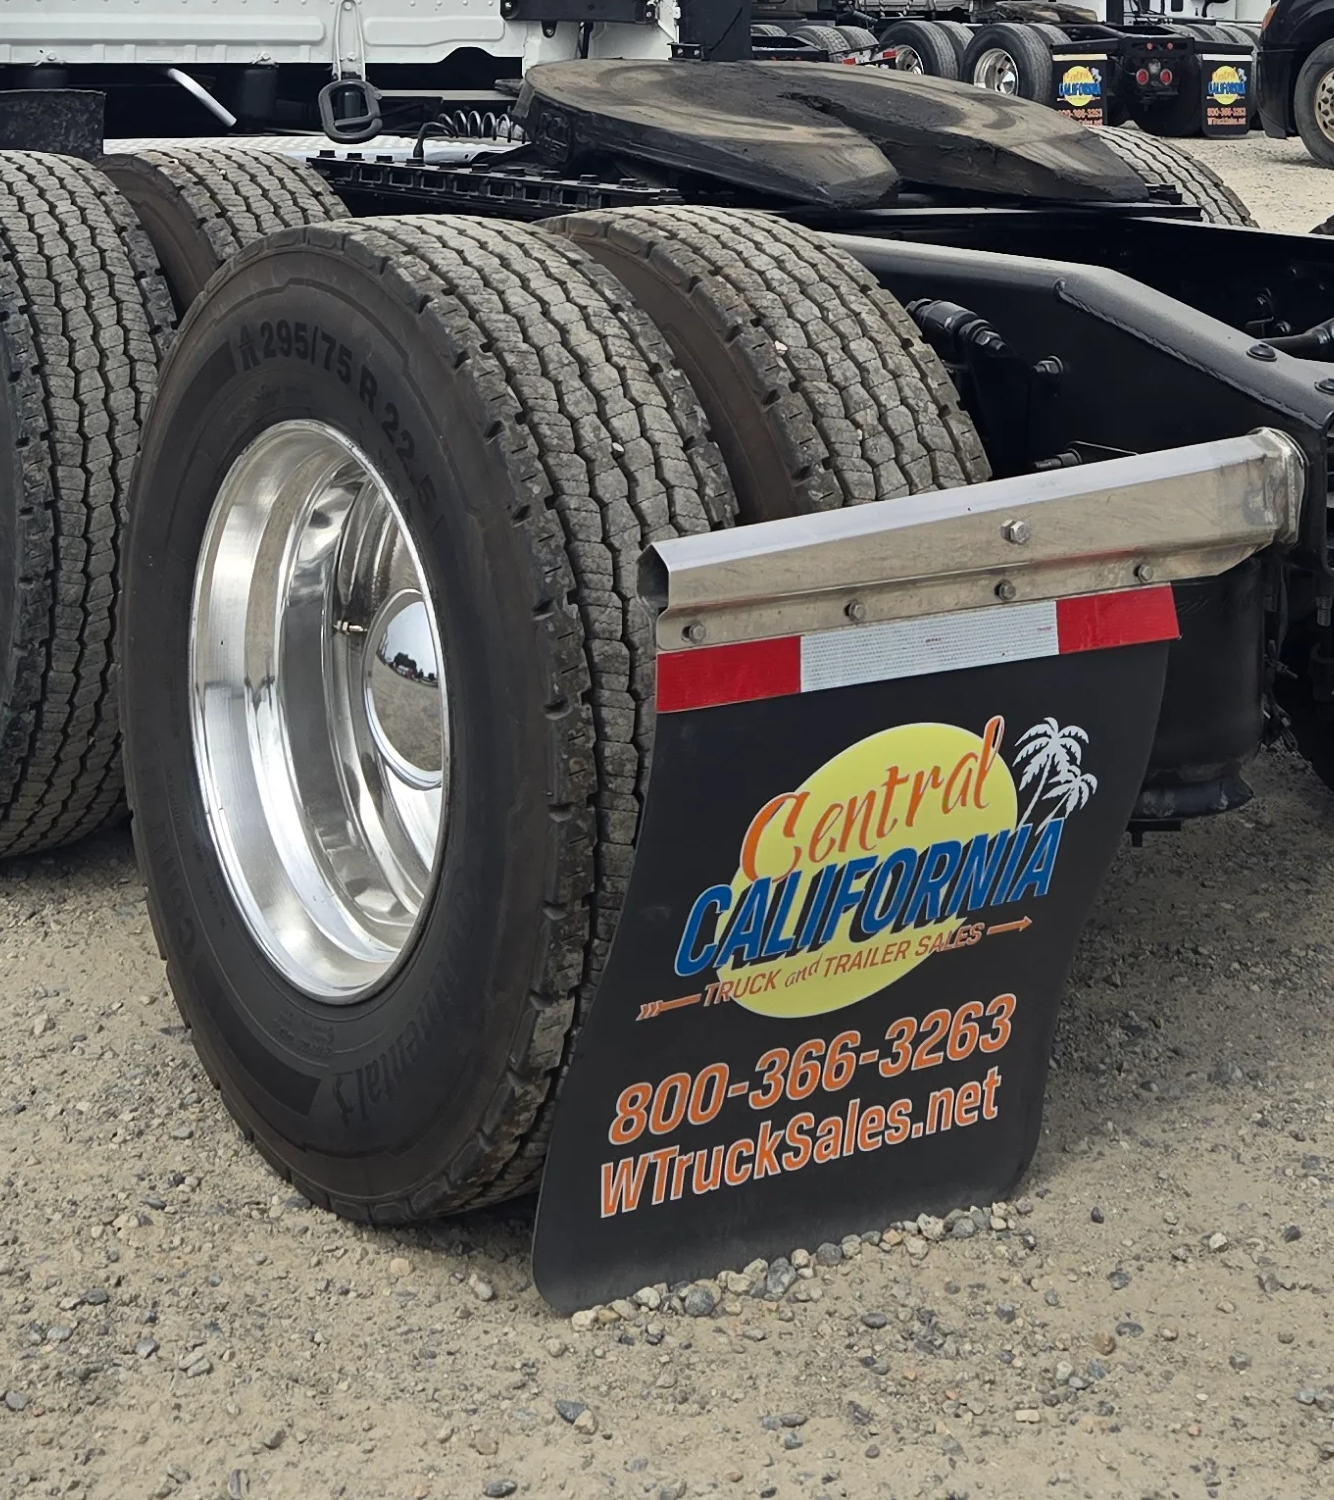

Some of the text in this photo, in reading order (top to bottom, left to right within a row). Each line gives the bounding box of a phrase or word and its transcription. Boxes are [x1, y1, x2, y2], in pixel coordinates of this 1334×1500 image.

[260, 319, 353, 385] 295/75
[359, 364, 378, 414] R
[739, 715, 1005, 883] Central
[674, 818, 1066, 977] CALIFORNIA
[703, 923, 986, 1007] TRUCK and TRAILER SALES
[599, 1066, 1002, 1218] WTruckSales.net
[608, 993, 1017, 1145] 800-366-3263
